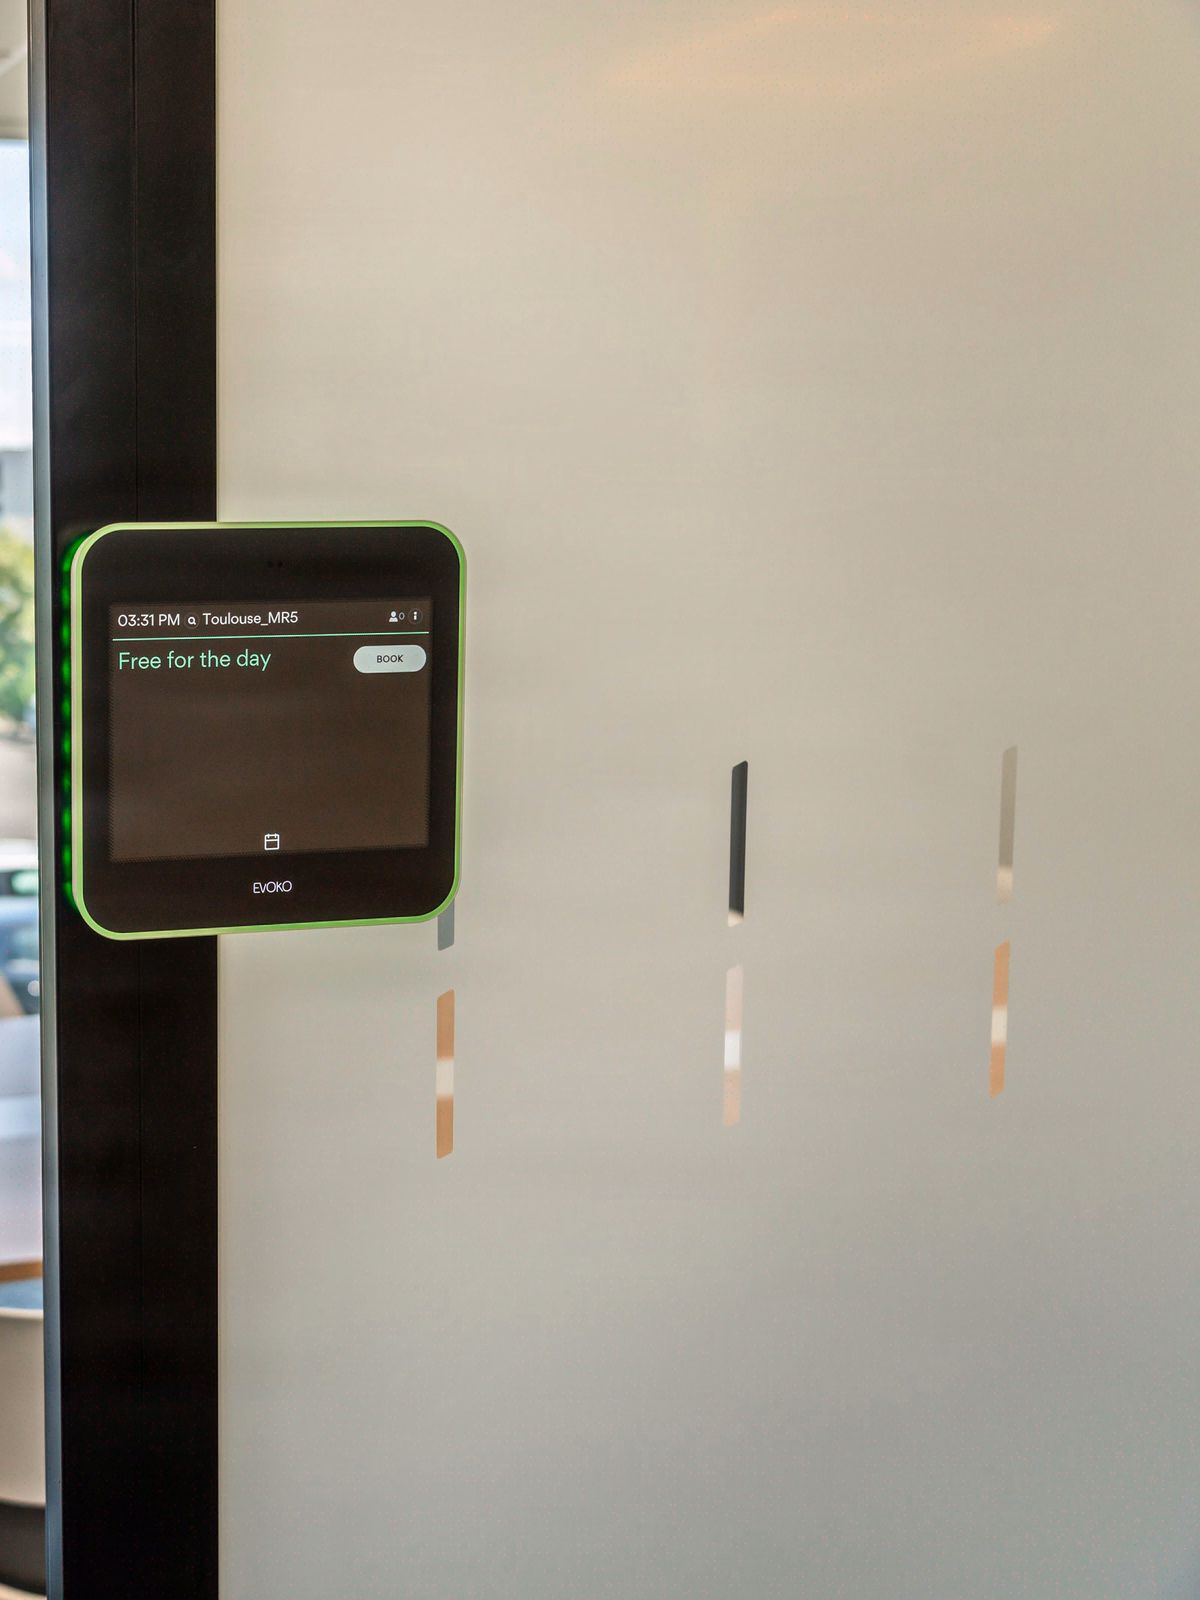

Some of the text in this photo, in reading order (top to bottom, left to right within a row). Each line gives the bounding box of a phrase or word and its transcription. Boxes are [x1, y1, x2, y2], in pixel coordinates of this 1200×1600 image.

[117, 613, 180, 627] 03:31 PM
[202, 611, 299, 626] Toulouse_MR5
[119, 648, 272, 672] Free for the day
[376, 654, 404, 664] BOOK
[252, 880, 293, 894] EVOKO
